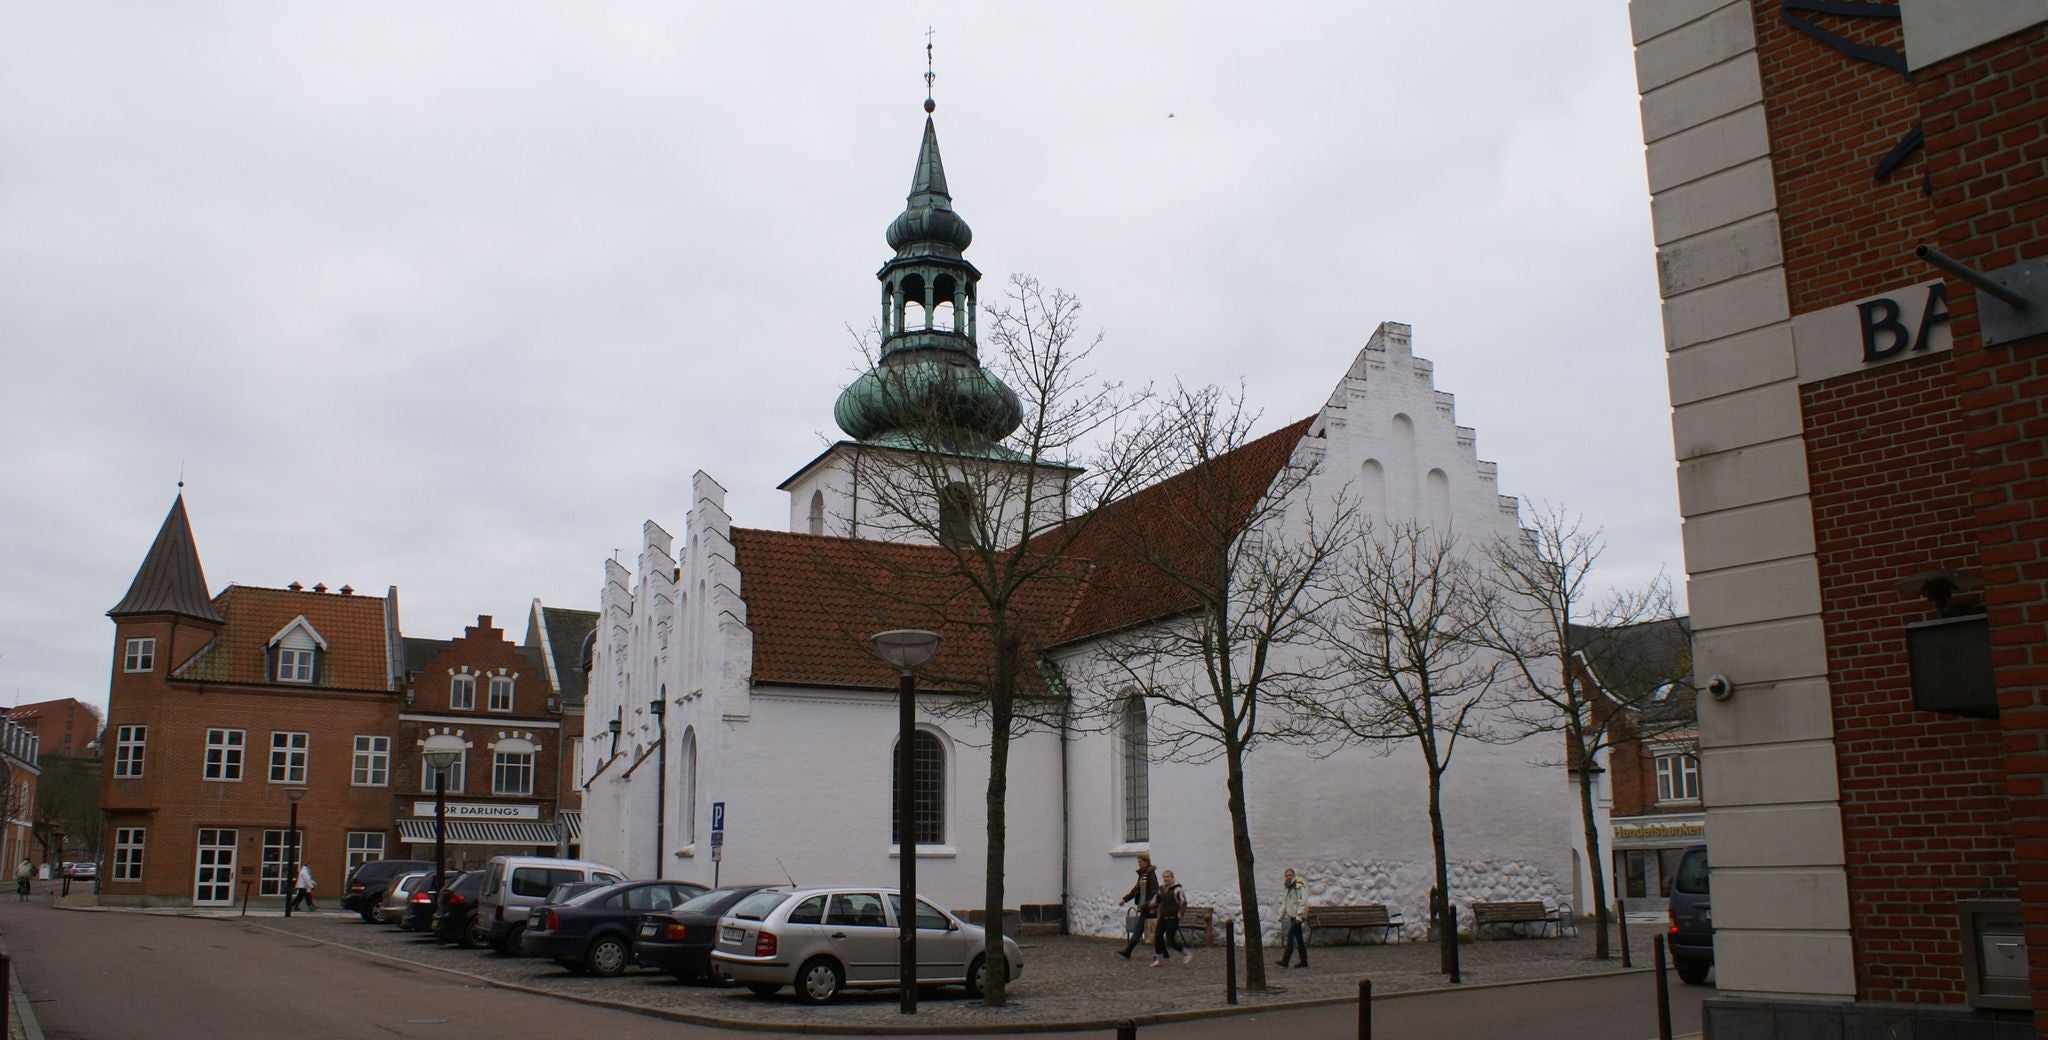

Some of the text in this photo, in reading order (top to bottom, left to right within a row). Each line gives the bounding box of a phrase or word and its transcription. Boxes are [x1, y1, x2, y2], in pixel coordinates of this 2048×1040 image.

[461, 806, 519, 816] DARLINGS
[714, 806, 722, 827] P
[1613, 824, 1704, 838] Handelsbanken
